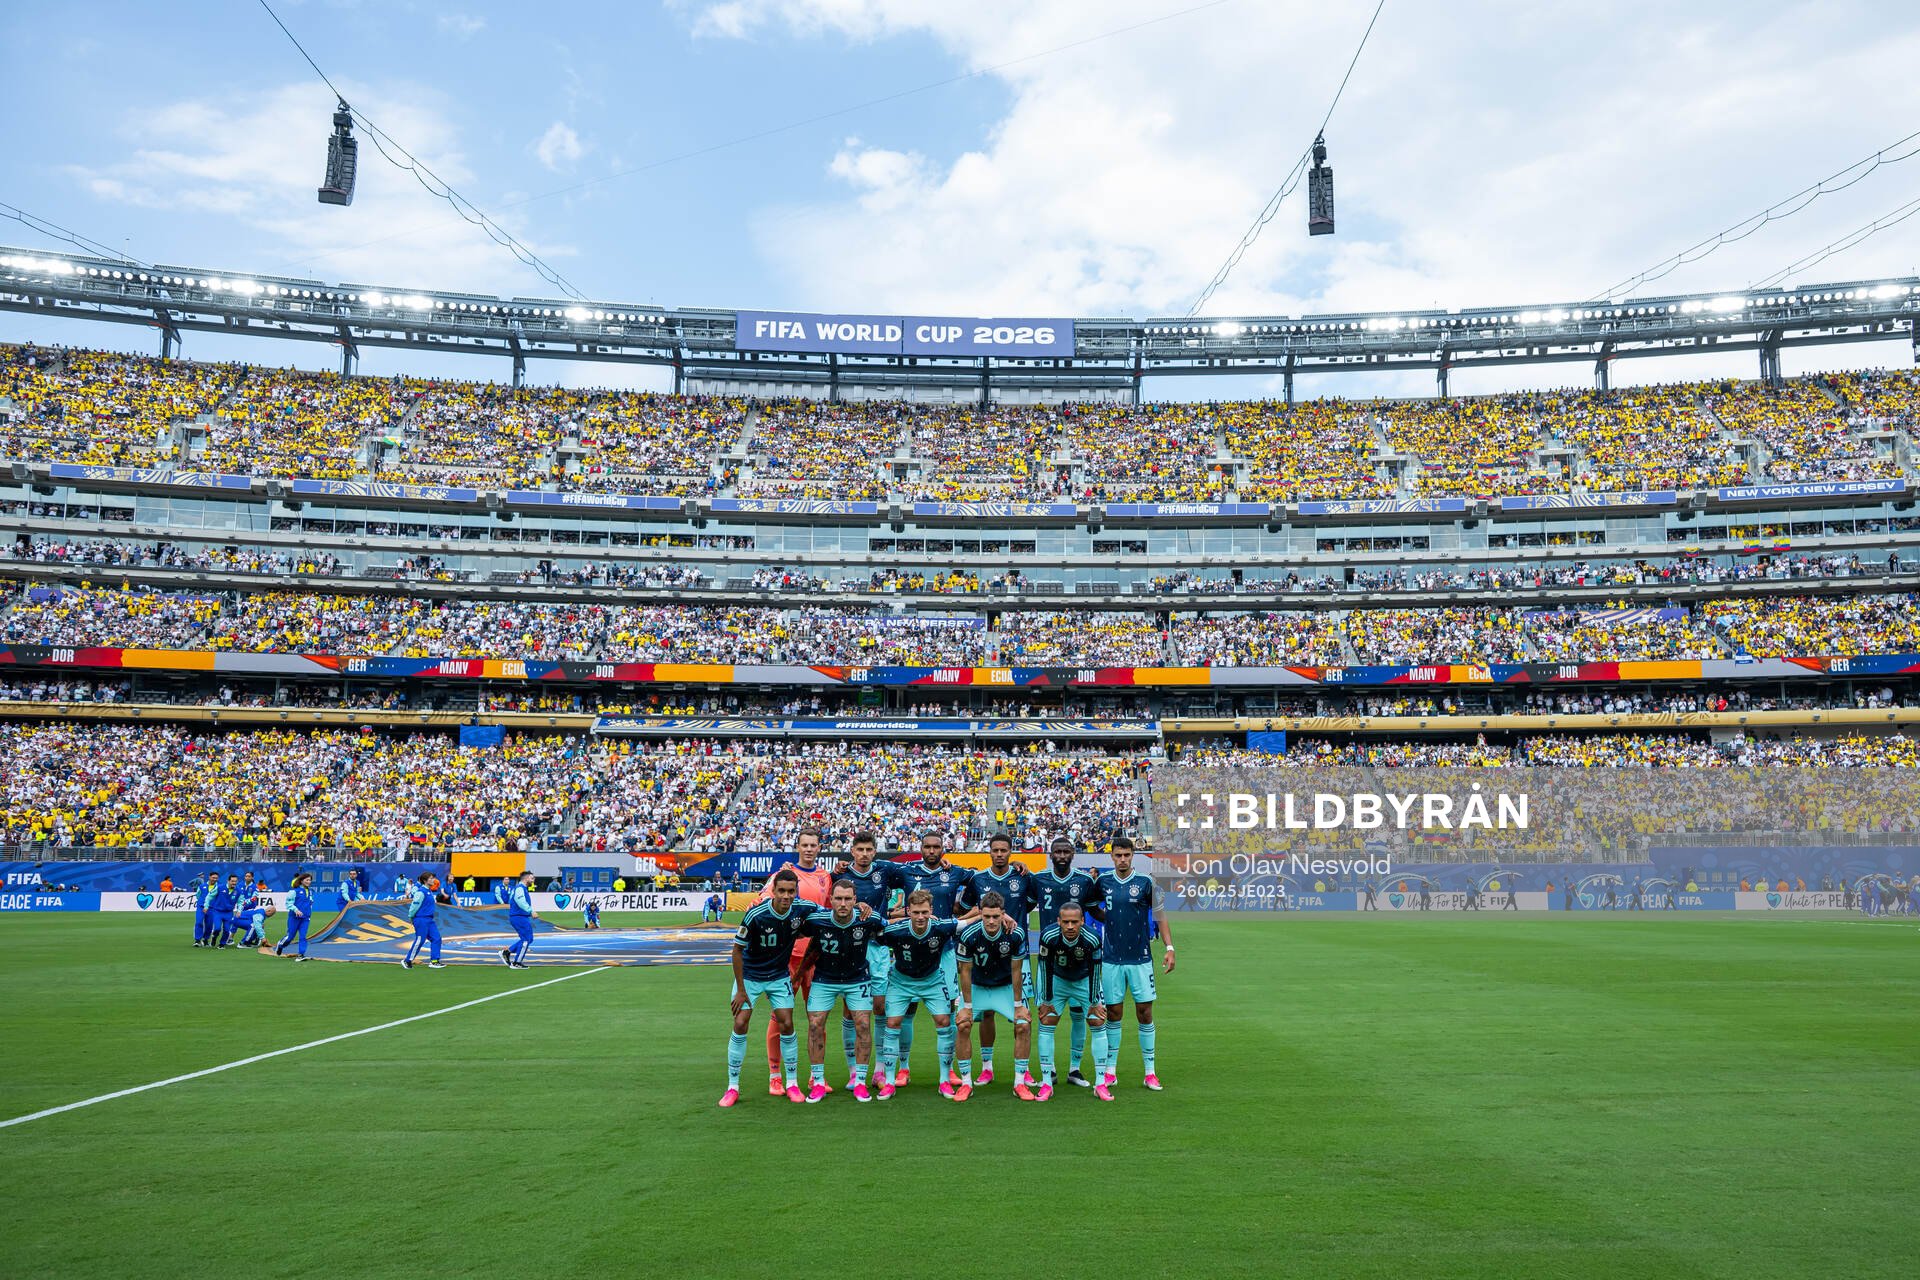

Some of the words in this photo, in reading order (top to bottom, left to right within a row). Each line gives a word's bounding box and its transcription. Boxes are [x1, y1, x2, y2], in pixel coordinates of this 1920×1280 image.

[755, 320, 806, 341] FIFA
[816, 322, 902, 342] WORLD
[915, 325, 963, 343] CUP
[973, 326, 1057, 345] 2026
[1727, 489, 1758, 497] NEW
[1762, 487, 1801, 496] YORK
[1803, 484, 1836, 494] NEW
[1839, 481, 1895, 492] JERSEY
[562, 494, 628, 507] #FIFAWorldCup
[1157, 504, 1219, 515] #FIFAWorldCup
[52, 648, 74, 663] DOR
[348, 659, 367, 672] GER
[439, 661, 469, 674] MANY
[502, 663, 526, 676] ECUA
[595, 665, 614, 678] DOR
[1559, 665, 1579, 678] DOR
[1830, 658, 1850, 672] GER
[850, 668, 867, 681] GER
[933, 669, 960, 682] MANY
[991, 669, 1013, 682] ECUA
[1078, 669, 1095, 682] DOR
[1326, 669, 1343, 682] GER
[1409, 667, 1436, 681] MANY
[836, 722, 918, 730] #FIFAWorldCup
[635, 857, 657, 872] GER
[739, 856, 773, 872] MANY
[815, 857, 839, 872] CUA
[7, 873, 43, 885] FIFA
[0, 894, 32, 909] EACE
[36, 896, 63, 906] FIFA
[156, 893, 185, 910] Unite
[256, 897, 275, 907] IFA
[458, 896, 483, 906] FIFA
[603, 894, 620, 910] For
[621, 895, 658, 909] PEACE
[663, 897, 688, 907] FIFA
[1044, 894, 1052, 909] 2
[1105, 895, 1113, 910] 5
[1299, 896, 1323, 906] FIFA
[1434, 893, 1450, 909] For
[1490, 896, 1507, 906] FIF
[1679, 896, 1702, 906] FIFA
[1784, 893, 1810, 910] Unite
[1811, 893, 1827, 909] For
[760, 933, 777, 947] 10
[820, 939, 839, 954] 22
[973, 953, 989, 967] 17
[783, 981, 794, 996] 1
